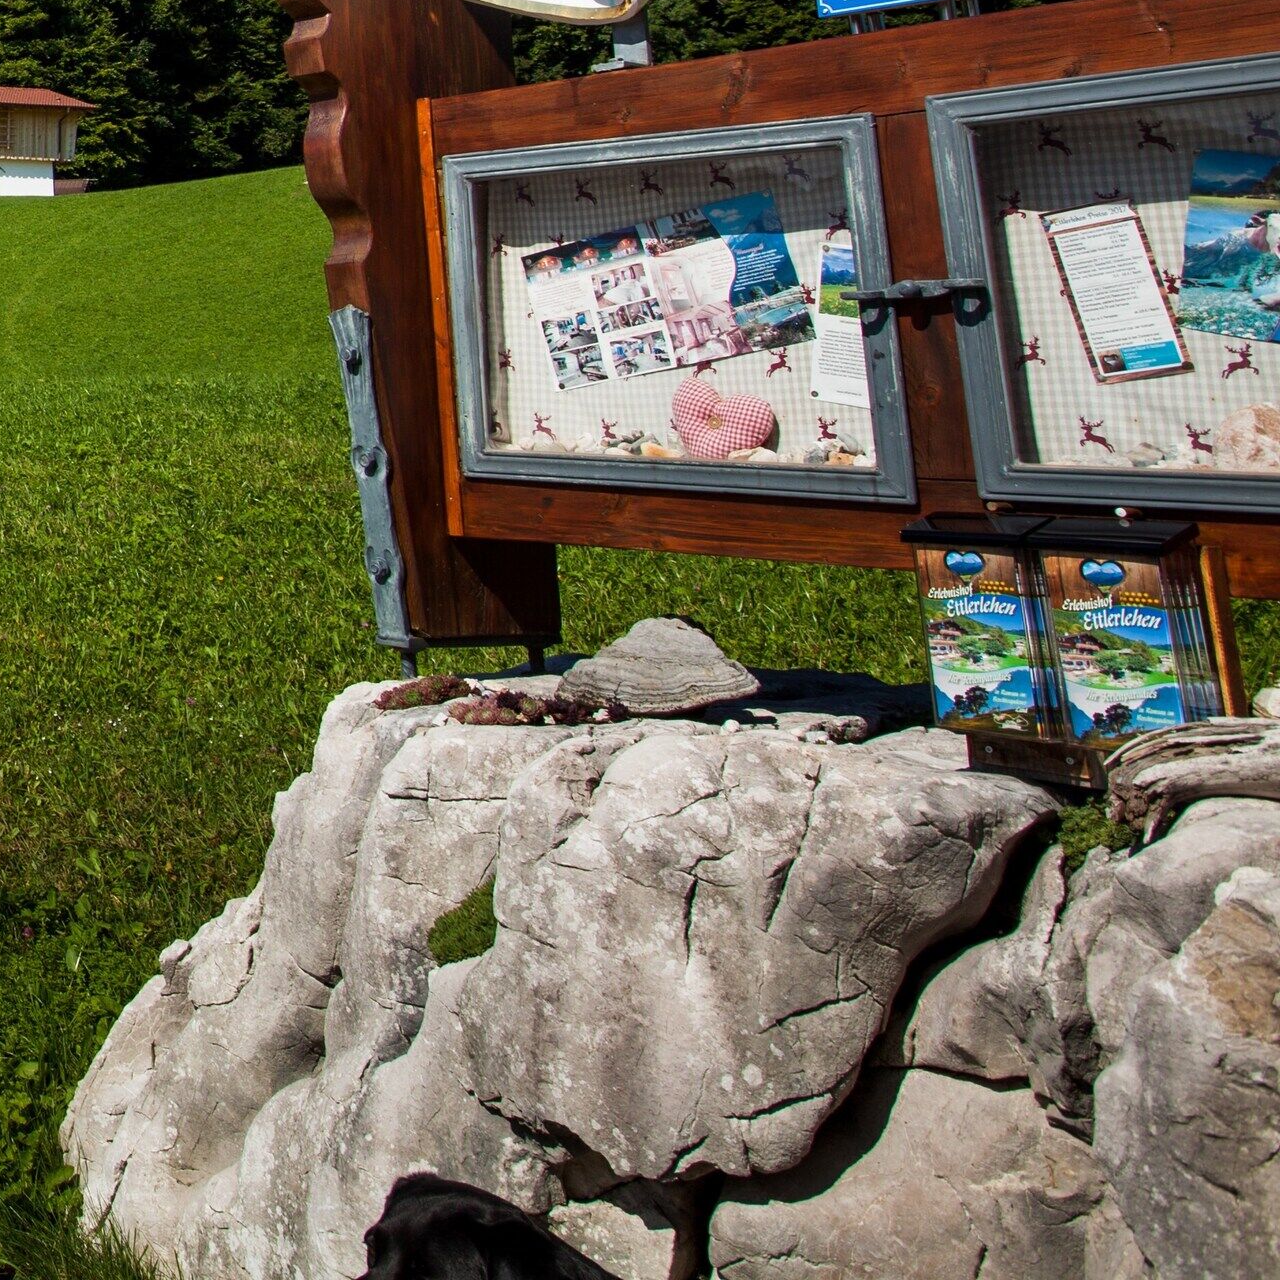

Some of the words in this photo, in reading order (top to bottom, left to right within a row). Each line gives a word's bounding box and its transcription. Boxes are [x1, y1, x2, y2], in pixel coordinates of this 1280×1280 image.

[1108, 205, 1127, 215] 2017
[928, 582, 973, 599] Erlebnishof
[946, 596, 1017, 618] Ettlerlehen
[1061, 593, 1113, 611] Erlebnishof
[1083, 608, 1162, 631] Ettlerlehen
